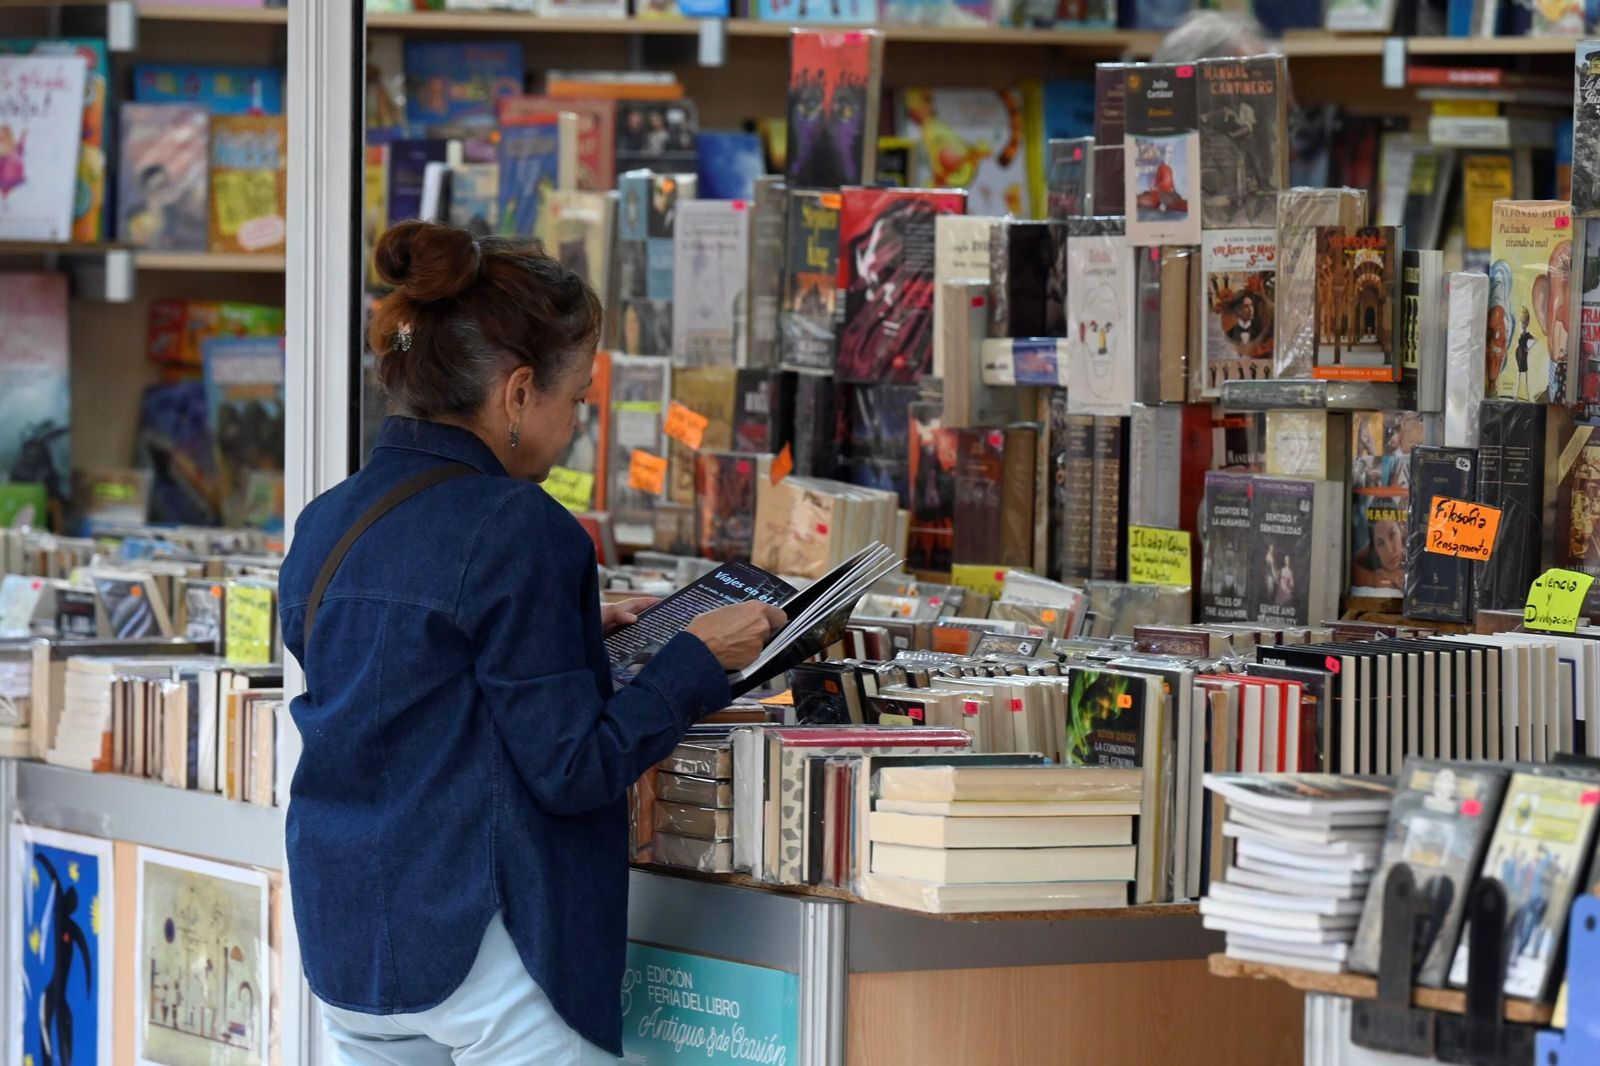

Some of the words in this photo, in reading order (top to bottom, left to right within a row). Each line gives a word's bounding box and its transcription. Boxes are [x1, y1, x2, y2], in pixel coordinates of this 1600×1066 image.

[1211, 517, 1220, 526] LA
[1219, 517, 1251, 528] ALHAMBRA
[1265, 511, 1292, 523] SENTIDO
[1431, 529, 1489, 557] Pensamiento
[714, 570, 746, 590] Viajes
[743, 585, 760, 597] en
[1281, 606, 1297, 617] AND
[1094, 741, 1102, 751] LA
[1102, 743, 1136, 756] CONQUISTA
[646, 964, 693, 990] EDICIÓN
[647, 984, 683, 1009] FERIA
[682, 990, 704, 1013] DEL
[704, 996, 741, 1020] LIBRO
[637, 1006, 706, 1054] Antiguo
[715, 1028, 731, 1053] de
[730, 1021, 787, 1066] Ocasión
